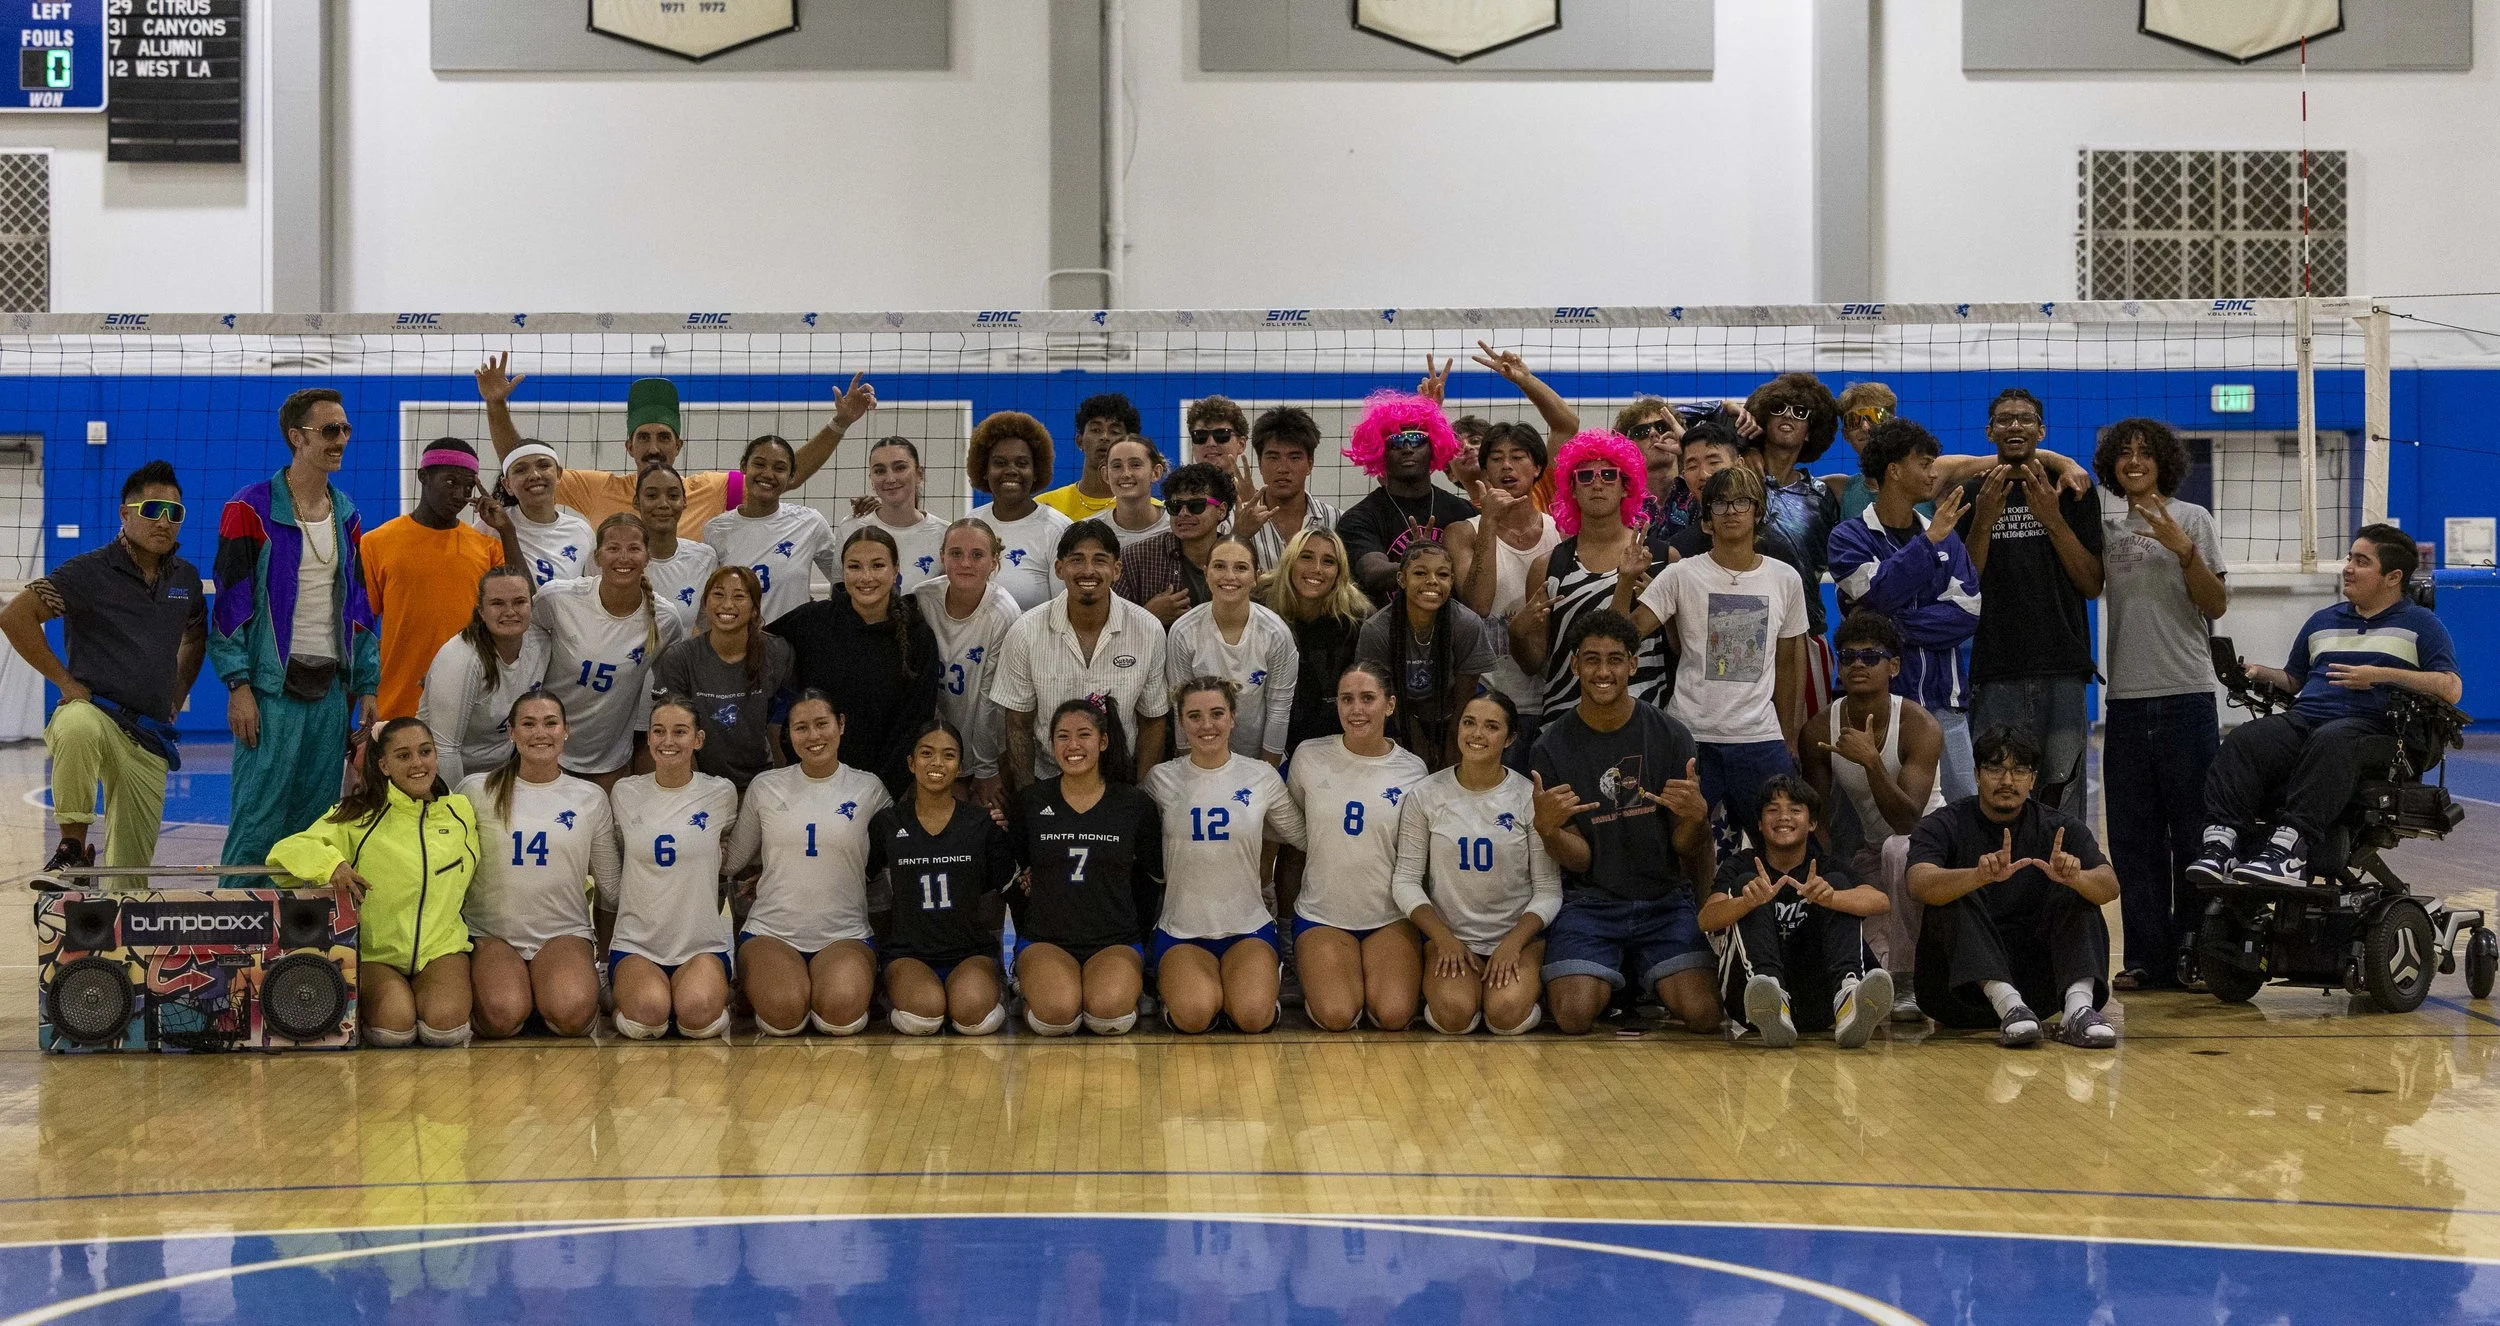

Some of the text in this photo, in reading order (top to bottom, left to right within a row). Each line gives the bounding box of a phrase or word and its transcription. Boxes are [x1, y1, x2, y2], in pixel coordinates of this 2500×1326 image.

[32, 3, 71, 20] LEFT
[109, 0, 211, 15] 29 CITRUS
[661, 2, 726, 13] 1971 1972
[109, 19, 227, 36] 31 CANYONS
[21, 29, 74, 47] FOULS
[109, 39, 203, 57] 7 ALUMNI
[46, 49, 71, 88] 0
[109, 60, 212, 77] 12 WEST LA
[30, 91, 64, 107] WON
[1554, 307, 1598, 318] SMC
[1841, 304, 1885, 315] SMC
[2212, 300, 2256, 310] SMC
[105, 314, 149, 324] SMC
[396, 313, 441, 323] SMC
[687, 313, 731, 323] SMC
[977, 311, 1021, 322] SMC
[1266, 310, 1310, 320] SMC
[2207, 310, 2258, 318] VOLLEYBALL
[2007, 506, 2030, 514] ROGER
[536, 559, 554, 586] 9
[576, 659, 617, 693] 15
[1190, 807, 1230, 841] 12
[1343, 800, 1365, 836] 8
[805, 823, 818, 857] 1
[1040, 833, 1120, 843] SANTA MONICA
[511, 831, 549, 866] 14
[654, 834, 676, 867] 6
[1457, 836, 1494, 872] 10
[898, 855, 972, 866] SANTA MONICA
[1069, 848, 1089, 881] 7
[920, 873, 952, 909] 11
[1774, 898, 1809, 922] MC
